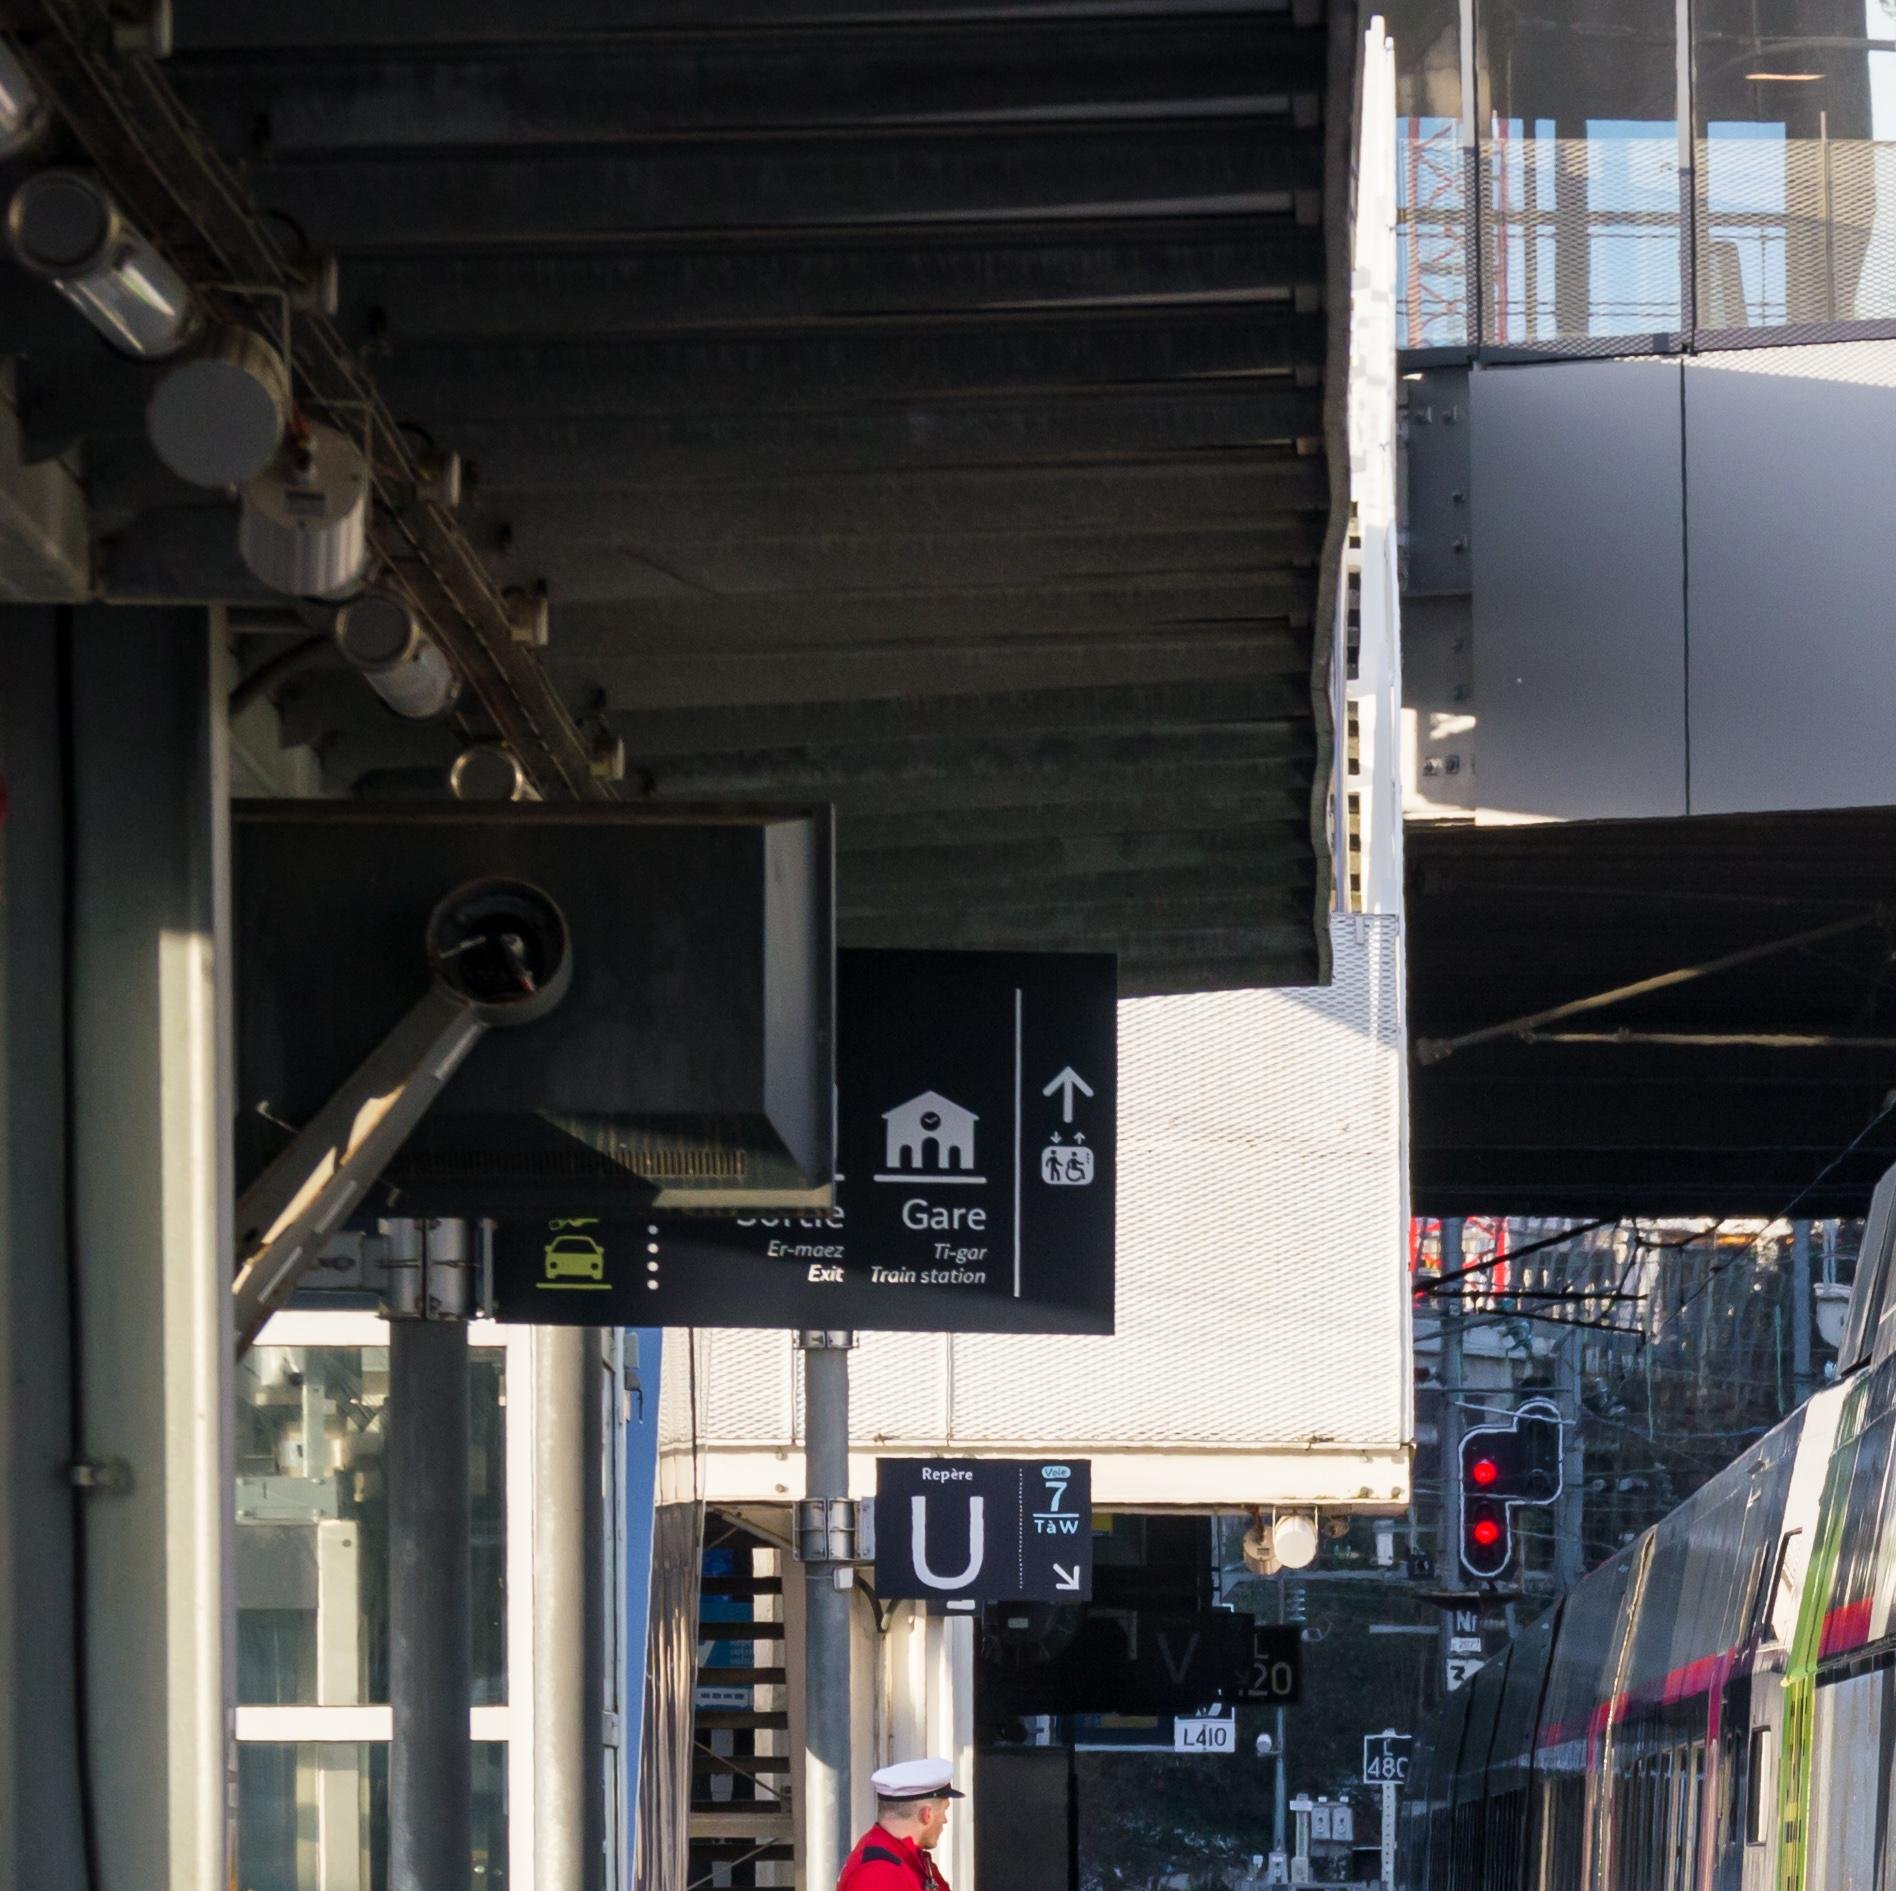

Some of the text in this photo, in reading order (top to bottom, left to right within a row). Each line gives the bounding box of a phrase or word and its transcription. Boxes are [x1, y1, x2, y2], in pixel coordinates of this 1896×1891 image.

[902, 1198, 987, 1230] Gare
[767, 1240, 845, 1258] Er-maez
[934, 1243, 987, 1264] Ti-gar
[807, 1264, 844, 1283] Exit
[871, 1266, 986, 1284] Train station
[922, 1467, 973, 1483] Repère
[1045, 1481, 1067, 1512] 7
[911, 1496, 984, 1590] U
[1238, 1660, 1293, 1697] 20
